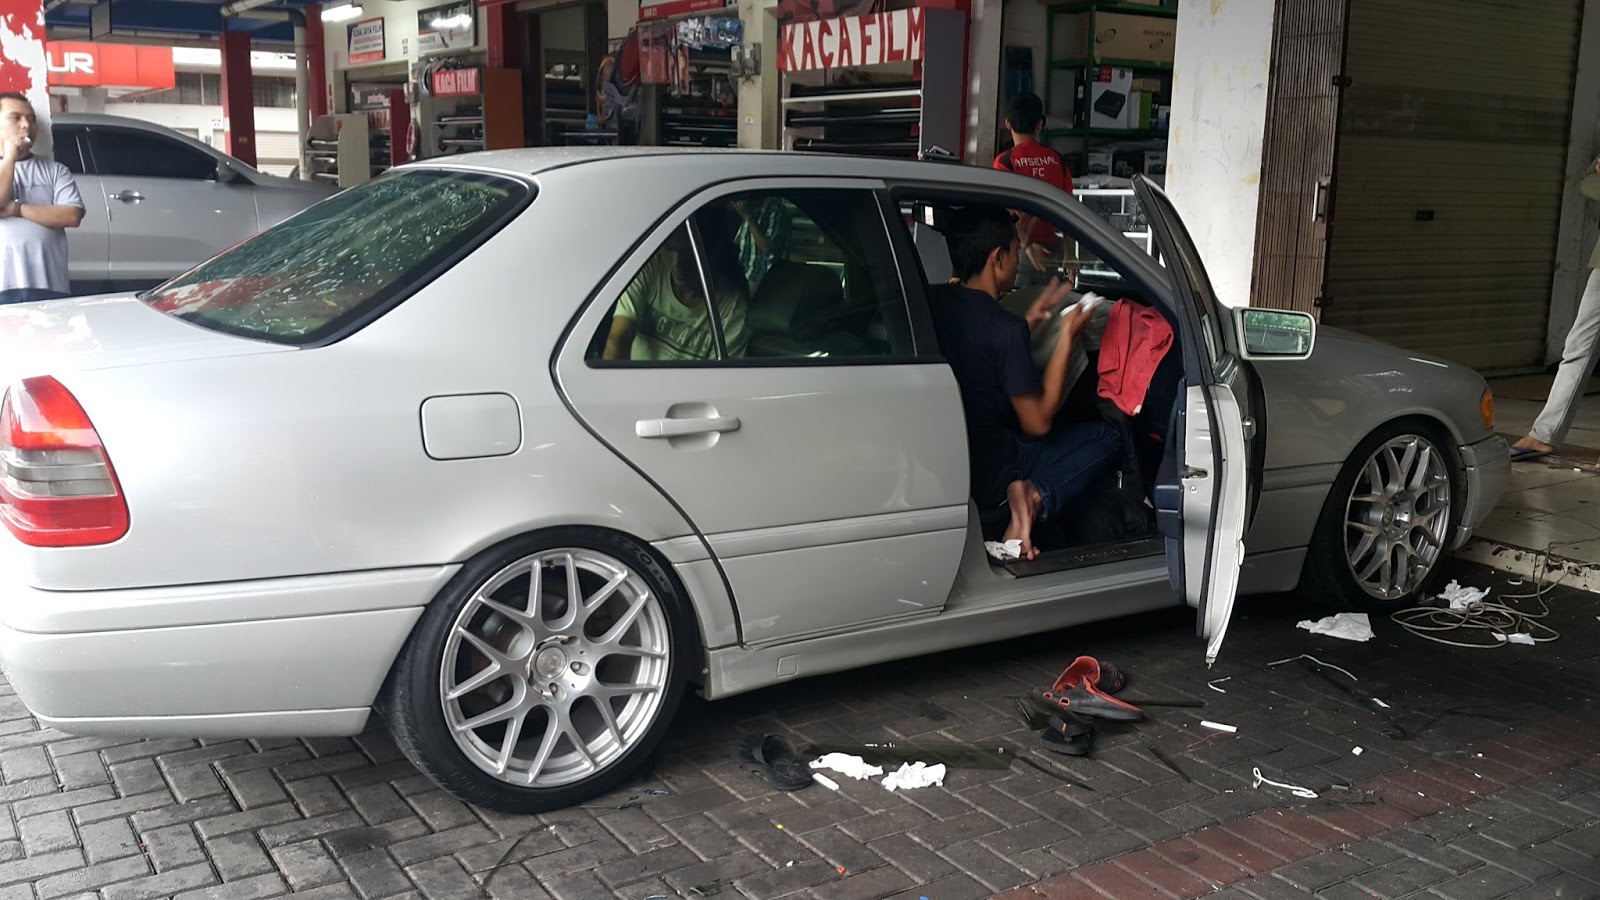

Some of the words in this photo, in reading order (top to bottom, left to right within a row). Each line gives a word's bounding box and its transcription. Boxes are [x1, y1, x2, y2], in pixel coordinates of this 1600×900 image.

[781, 17, 852, 73] KACA
[858, 7, 925, 65] FILM
[456, 69, 476, 93] FILM
[1014, 155, 1059, 167] ARSENAL
[1032, 167, 1045, 177] FC
